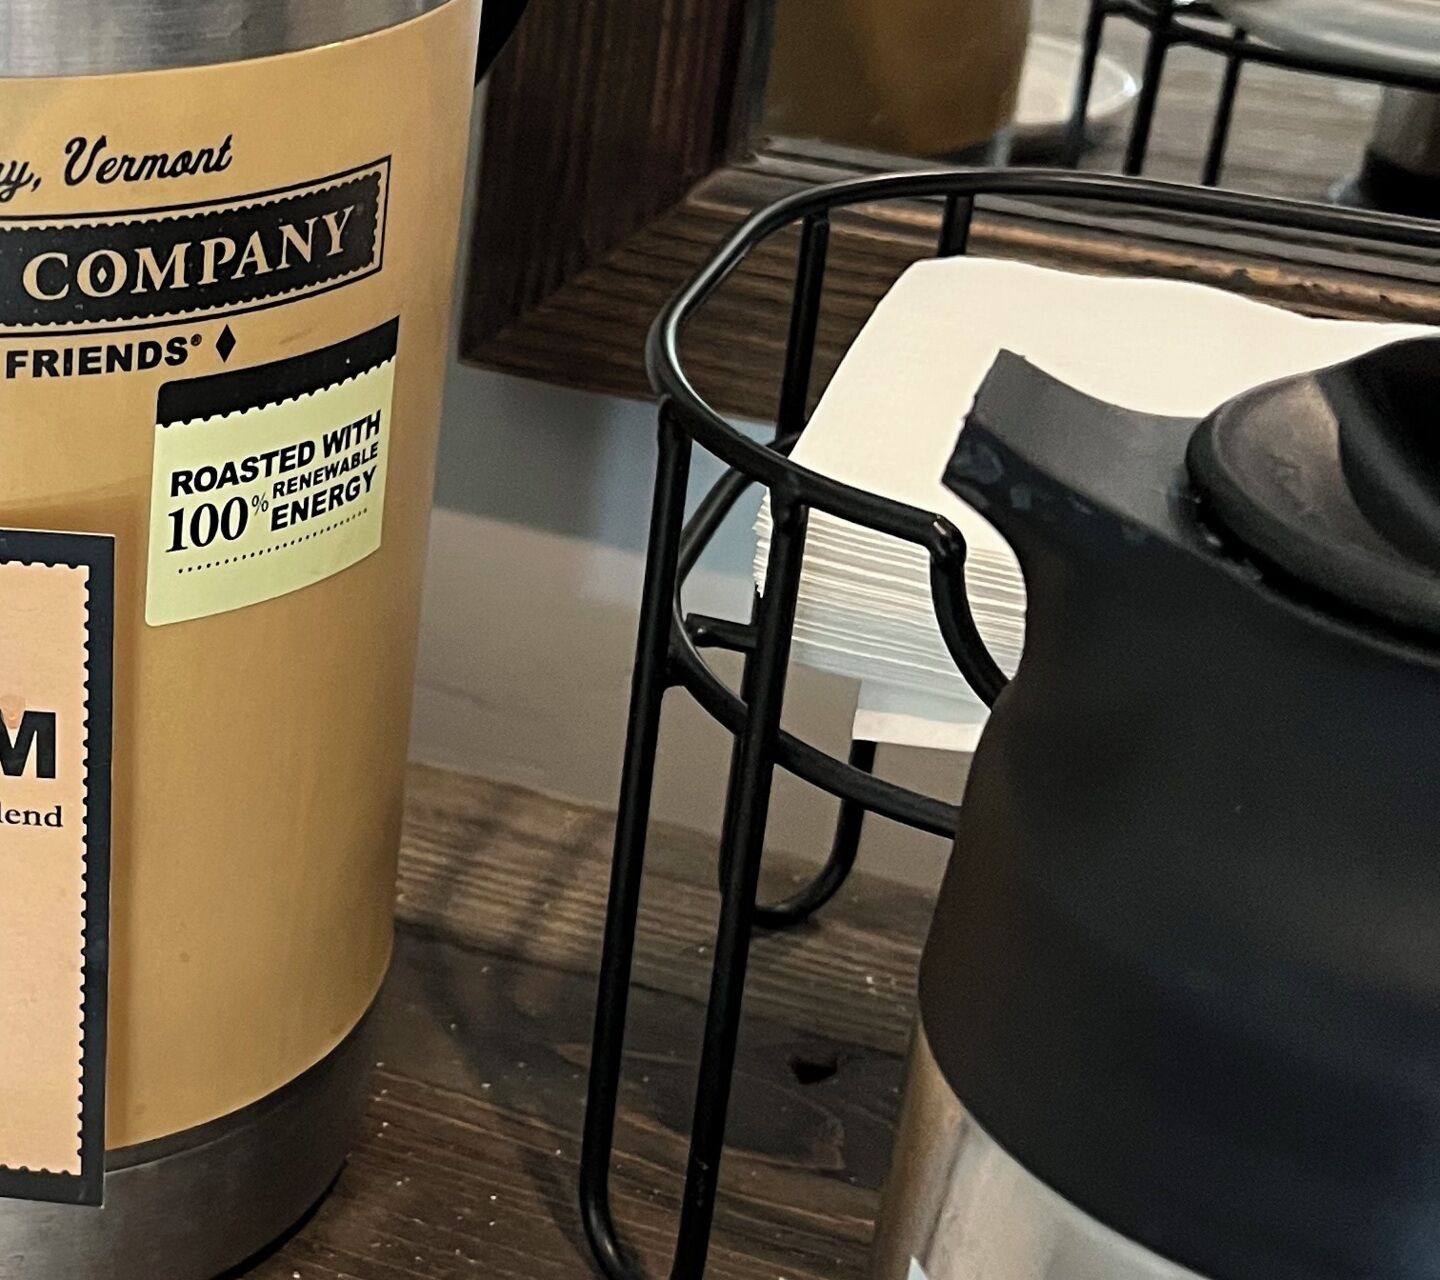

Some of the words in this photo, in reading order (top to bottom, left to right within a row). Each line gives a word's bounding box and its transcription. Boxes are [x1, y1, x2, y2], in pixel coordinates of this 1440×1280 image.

[64, 134, 234, 186] Vermont
[22, 205, 355, 301] COMPANY
[165, 491, 269, 554] 100%
[272, 441, 379, 499] RENEWABLE
[170, 440, 316, 498] ROASTED
[322, 409, 382, 459] WITH
[270, 465, 377, 532] ENERGY
